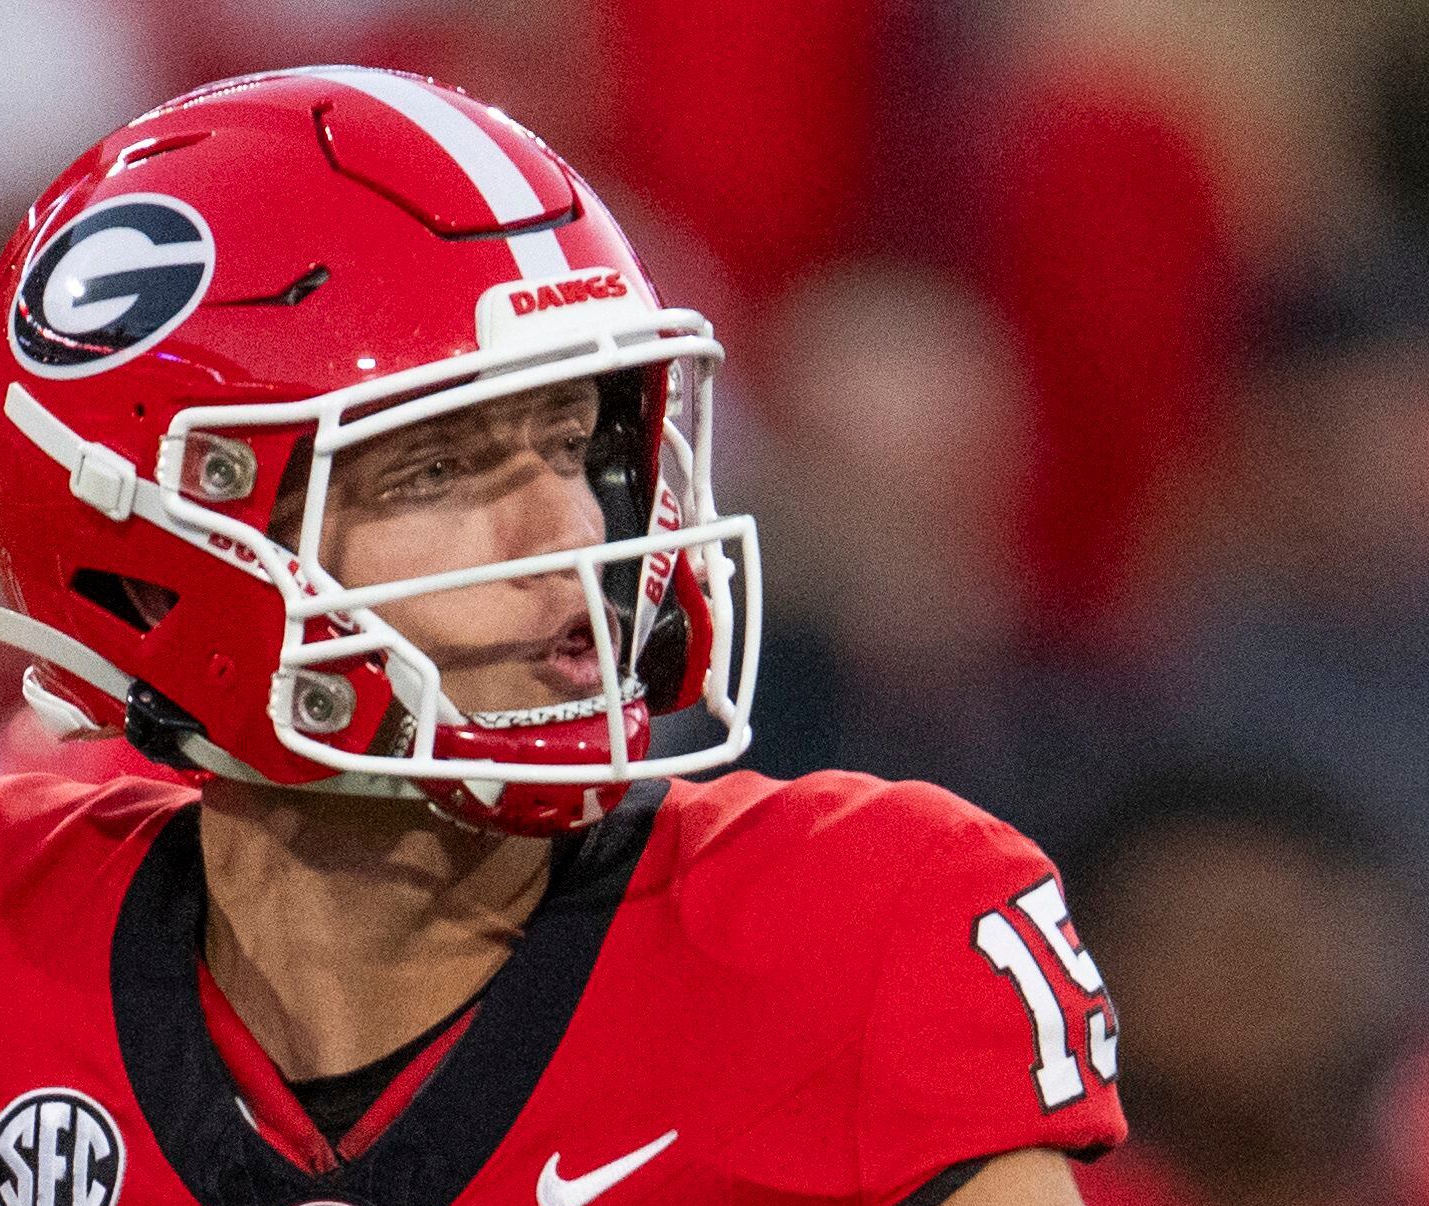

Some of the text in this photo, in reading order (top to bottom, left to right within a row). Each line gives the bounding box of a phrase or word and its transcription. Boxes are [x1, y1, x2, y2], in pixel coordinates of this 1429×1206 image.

[9, 195, 213, 377] G
[509, 272, 628, 316] DAWGS
[970, 873, 1120, 1113] 15
